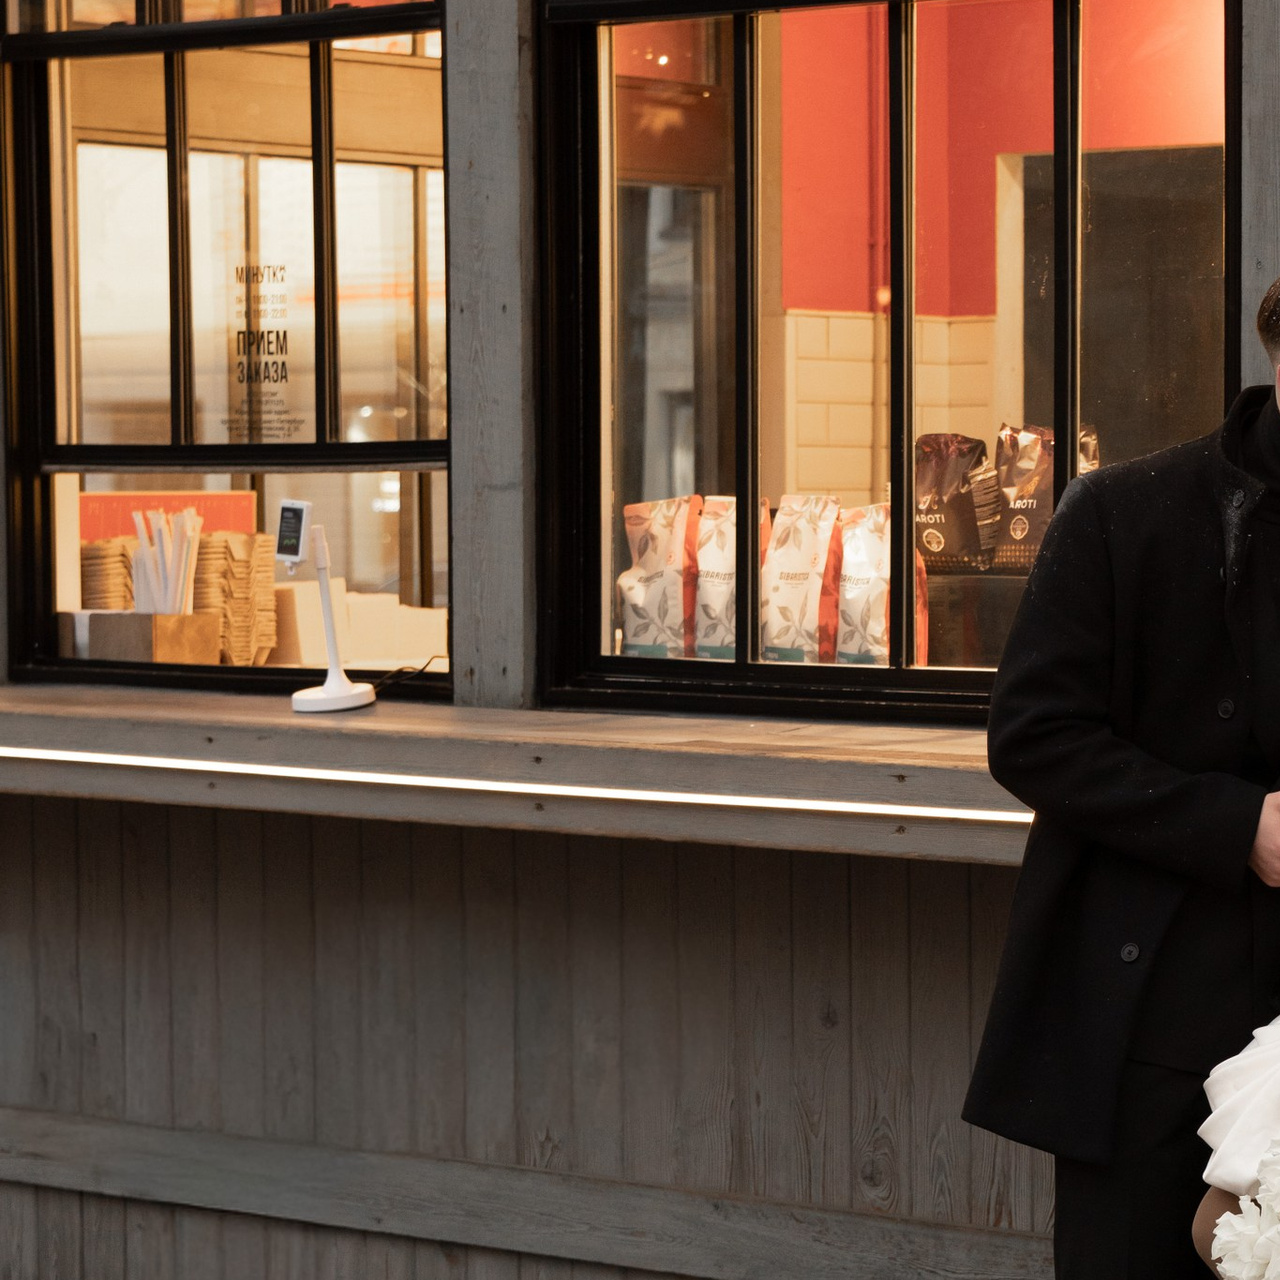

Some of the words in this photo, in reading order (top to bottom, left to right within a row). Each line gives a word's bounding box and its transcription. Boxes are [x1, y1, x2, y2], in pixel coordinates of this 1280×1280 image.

[237, 330, 288, 355] ПРИЕМ
[237, 361, 289, 384] ЗАКАЗА
[1008, 499, 1037, 509] AROTI
